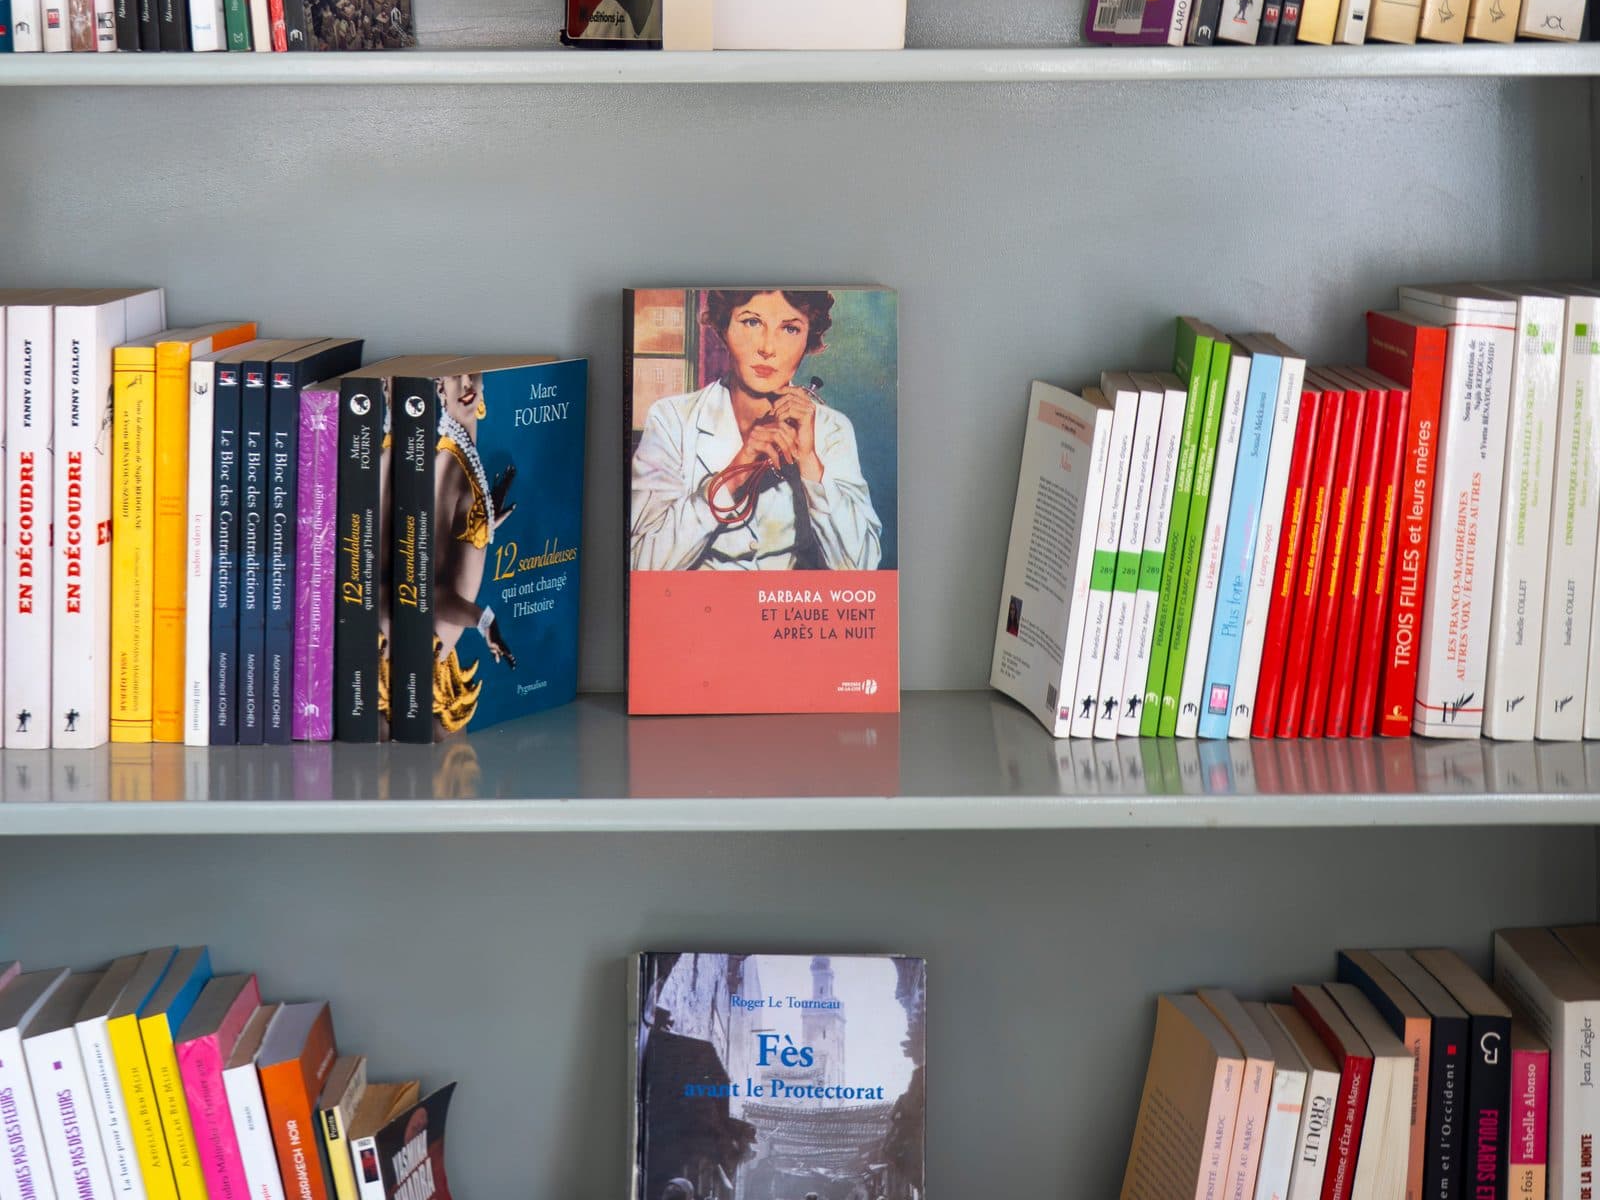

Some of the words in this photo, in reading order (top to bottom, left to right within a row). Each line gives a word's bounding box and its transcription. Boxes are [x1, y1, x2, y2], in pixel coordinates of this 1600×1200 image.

[22, 339, 33, 385] GALLOT
[529, 382, 558, 401] Marc
[22, 389, 33, 428] FANNY
[514, 401, 570, 428] FOURNY
[219, 429, 234, 447] Le
[1118, 434, 1129, 459] disparu
[1412, 420, 1432, 474] mères
[219, 451, 234, 481] Bloc
[1116, 460, 1126, 482] auront
[219, 488, 234, 507] des
[1111, 484, 1123, 509] femmes
[1406, 479, 1426, 521] leurs
[1470, 471, 1482, 521] AUTRES
[15, 451, 35, 578] DÉCOUDRE
[1110, 511, 1118, 520] les
[1107, 522, 1116, 544] Quand
[1168, 531, 1179, 562] MAROC
[1407, 526, 1423, 544] et
[217, 510, 233, 609] Contradictions
[492, 540, 518, 582] 12
[517, 536, 578, 573] scandaleuses
[1100, 565, 1114, 577] 289
[1167, 562, 1174, 571] AU
[1448, 490, 1469, 635] FRANCO-MAGHRÉBINES
[1462, 522, 1478, 592] ÉCRITURES
[501, 583, 517, 603] qui
[518, 580, 535, 596] ont
[536, 570, 568, 594] changé
[1163, 574, 1174, 602] CLIMAT
[1226, 575, 1244, 605] forte
[1399, 549, 1420, 608] FILLES
[18, 583, 34, 615] EN
[513, 597, 555, 619] l'Histoire
[757, 589, 823, 605] BARBARA
[829, 589, 877, 604] WOOD
[1162, 602, 1169, 613] ET
[761, 608, 778, 622] ET
[784, 608, 830, 622] L'AUBE
[836, 608, 876, 622] VIENT
[1156, 614, 1167, 646] FEMMES
[1220, 608, 1240, 638] Plus
[1461, 600, 1472, 631] VOIX
[773, 621, 814, 641] APRÈS
[819, 626, 838, 640] LA
[844, 626, 876, 640] NUIT
[1393, 612, 1415, 668] TROIS
[1446, 638, 1457, 661] LES
[1456, 633, 1469, 680] AUTRES
[218, 652, 228, 696] Mohamed
[516, 678, 547, 697] Pygmalion
[218, 697, 228, 727] KOHEN
[730, 995, 765, 1011] Roger
[768, 996, 783, 1008] Le
[785, 997, 841, 1010] Tourneau
[755, 1033, 814, 1068] Fès
[1579, 1016, 1595, 1058] Ziegler
[93, 1042, 116, 1114] reconnaissance
[684, 1082, 739, 1097] avant
[746, 1078, 763, 1097] le
[770, 1079, 884, 1100] Protectorat
[1346, 1072, 1361, 1105] Maroc
[1523, 1063, 1537, 1108] Alonso
[1579, 1061, 1594, 1088] Jean
[0, 1087, 19, 1125] FLEURS
[1346, 1107, 1355, 1122] au
[1440, 1063, 1456, 1148] l'Occident
[4, 1124, 24, 1144] DES
[108, 1117, 118, 1127] la
[286, 1119, 302, 1145] NOIR
[1303, 1095, 1327, 1167] GROULT
[1522, 1110, 1535, 1160] Isabelle
[111, 1130, 125, 1152] pour
[1338, 1123, 1353, 1155] d'État
[1476, 1108, 1499, 1181] FOULARDS
[1580, 1134, 1592, 1167] HONTE
[10, 1145, 28, 1165] PAS
[115, 1155, 129, 1176] lutte
[1440, 1155, 1450, 1170] et
[122, 1179, 133, 1191] La
[292, 1148, 314, 1200] ARRAKECH
[1520, 1170, 1533, 1193] fois
[1580, 1171, 1592, 1184] LA
[1580, 1187, 1592, 1200] DE
